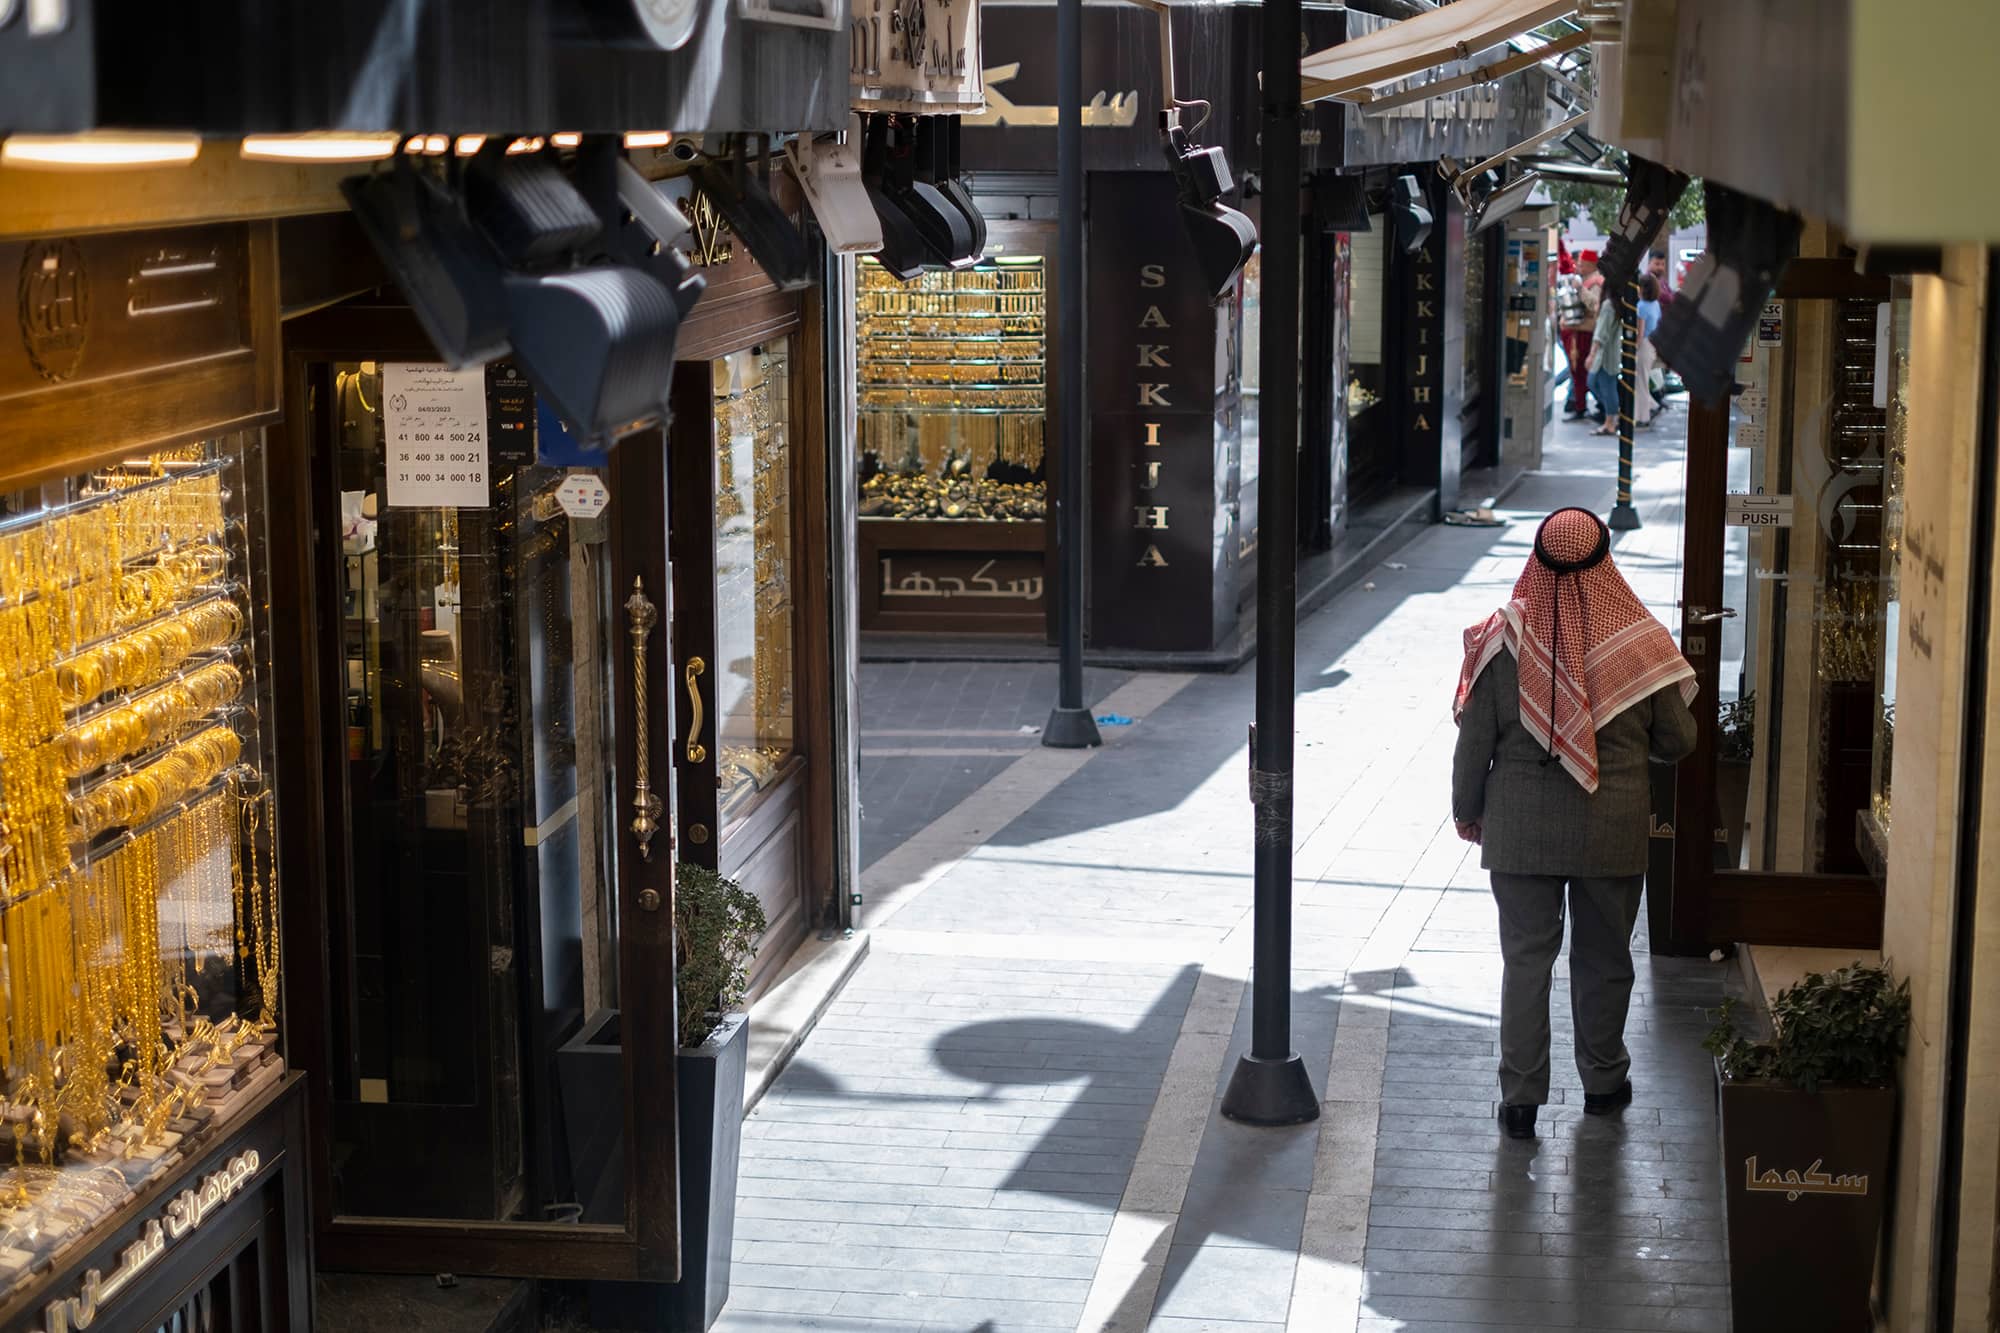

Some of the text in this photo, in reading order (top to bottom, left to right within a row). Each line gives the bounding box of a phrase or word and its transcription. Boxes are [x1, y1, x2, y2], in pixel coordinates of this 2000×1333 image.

[1413, 248, 1434, 430] AKKIJHA
[1134, 264, 1171, 567] SAKKIJHA
[467, 432, 480, 442] 24
[468, 452, 480, 462] 21
[469, 473, 481, 482] 18
[1742, 513, 1779, 524] PUSH
[880, 558, 1043, 600] سكجها
[163, 1149, 259, 1238] مجوهرات
[1746, 1155, 1868, 1201] سكجها
